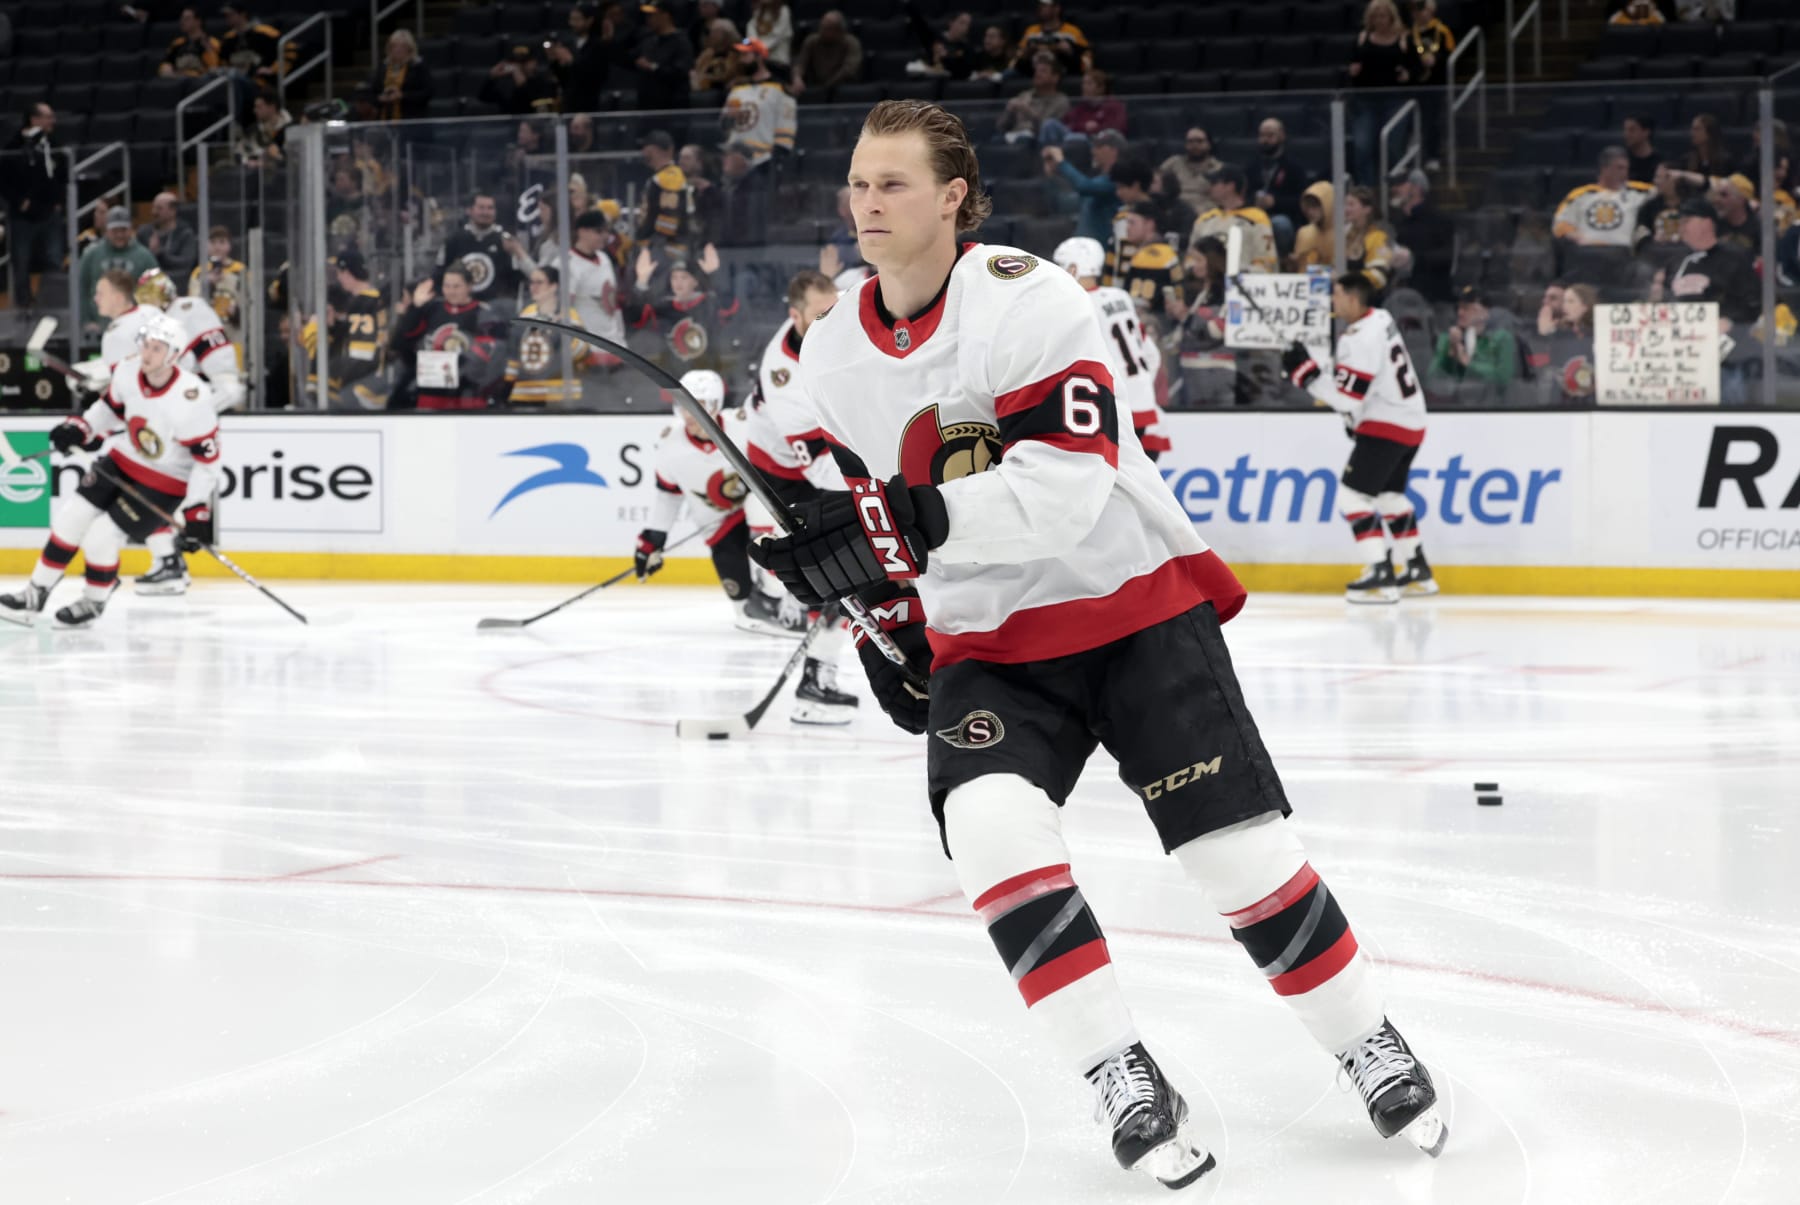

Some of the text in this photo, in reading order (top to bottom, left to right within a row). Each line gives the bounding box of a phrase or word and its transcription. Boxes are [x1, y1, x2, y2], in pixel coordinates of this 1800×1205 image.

[1274, 281, 1309, 300] WE
[349, 313, 375, 334] 73
[1334, 368, 1357, 393] 21
[1062, 374, 1102, 439] 6
[1141, 756, 1223, 801] CCM
